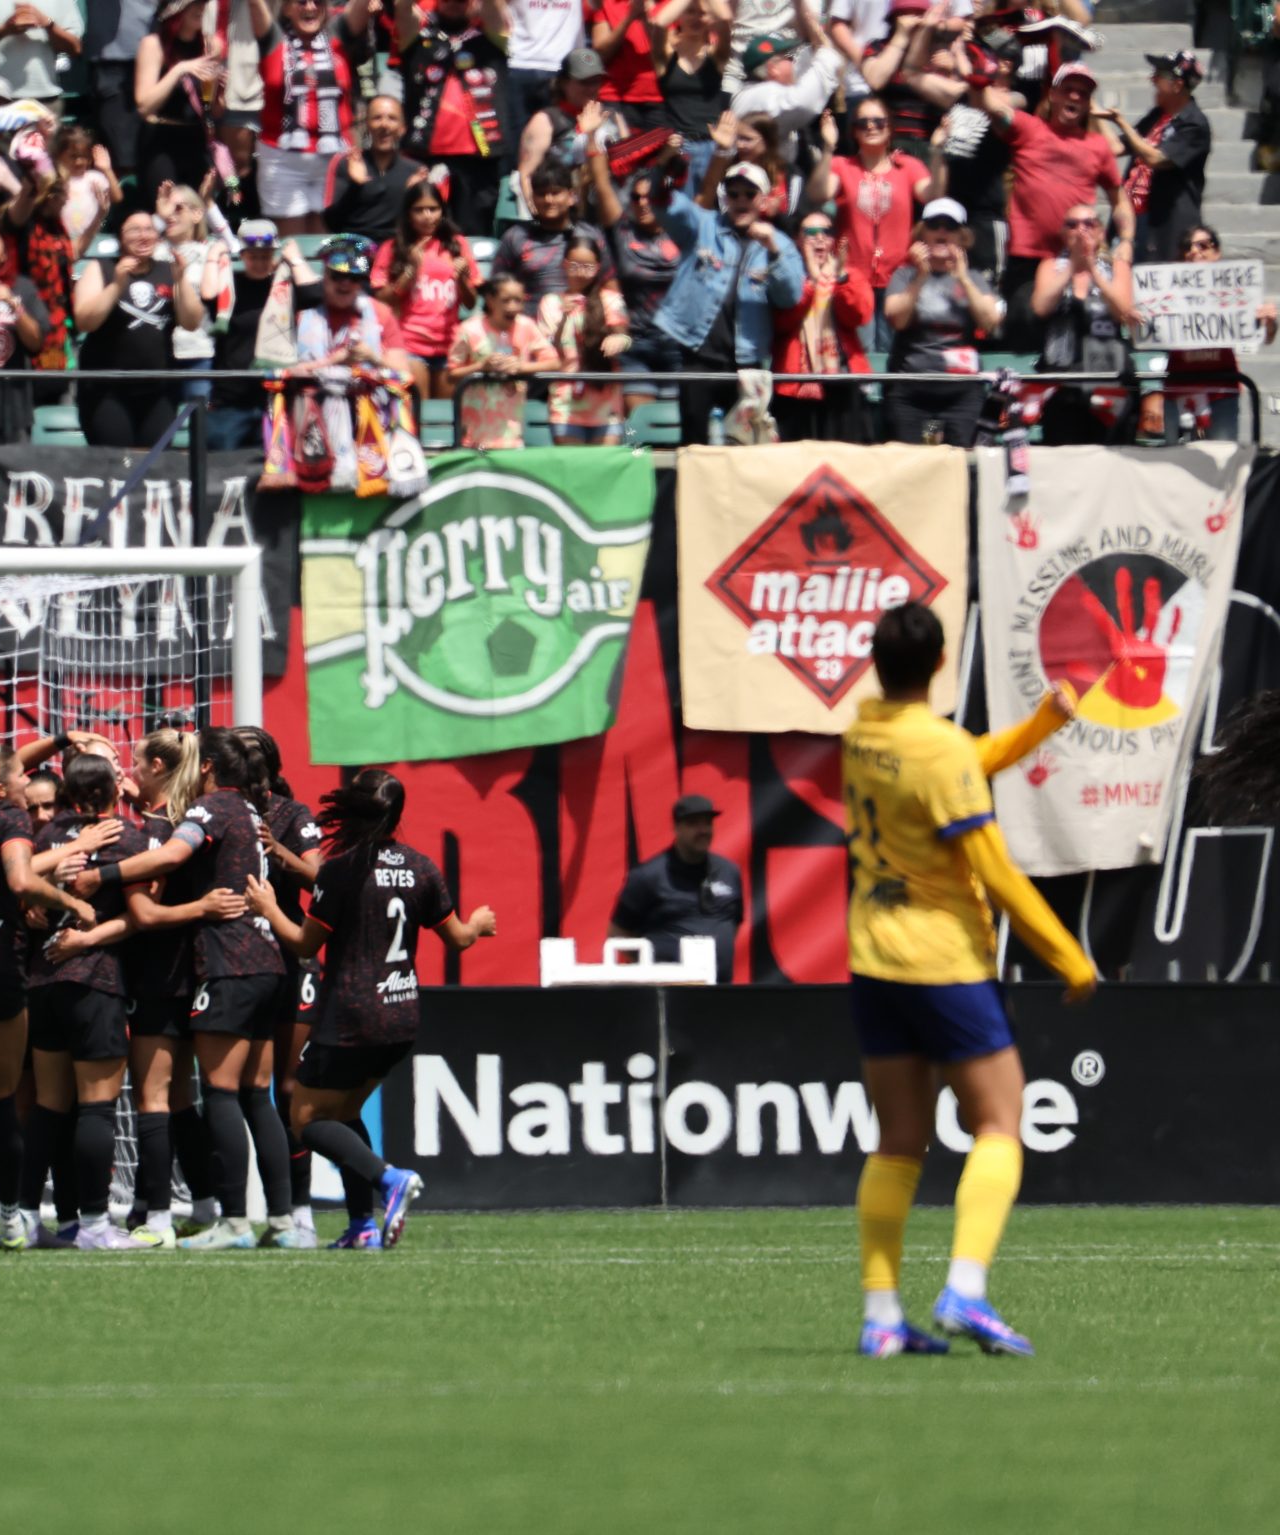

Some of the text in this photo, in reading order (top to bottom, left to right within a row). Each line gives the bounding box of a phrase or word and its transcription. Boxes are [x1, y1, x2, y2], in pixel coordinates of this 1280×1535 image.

[1135, 266, 1259, 291] WE ARE HERE
[3, 471, 257, 548] REINA
[567, 565, 631, 612] air
[1010, 537, 1092, 634] MISSING
[1099, 526, 1153, 551] AND
[747, 613, 877, 659] attac
[814, 659, 843, 680] 29
[374, 868, 416, 889] REYES
[385, 897, 408, 964] 2
[301, 972, 317, 1005] 6
[413, 1053, 1080, 1157] Nationwe
